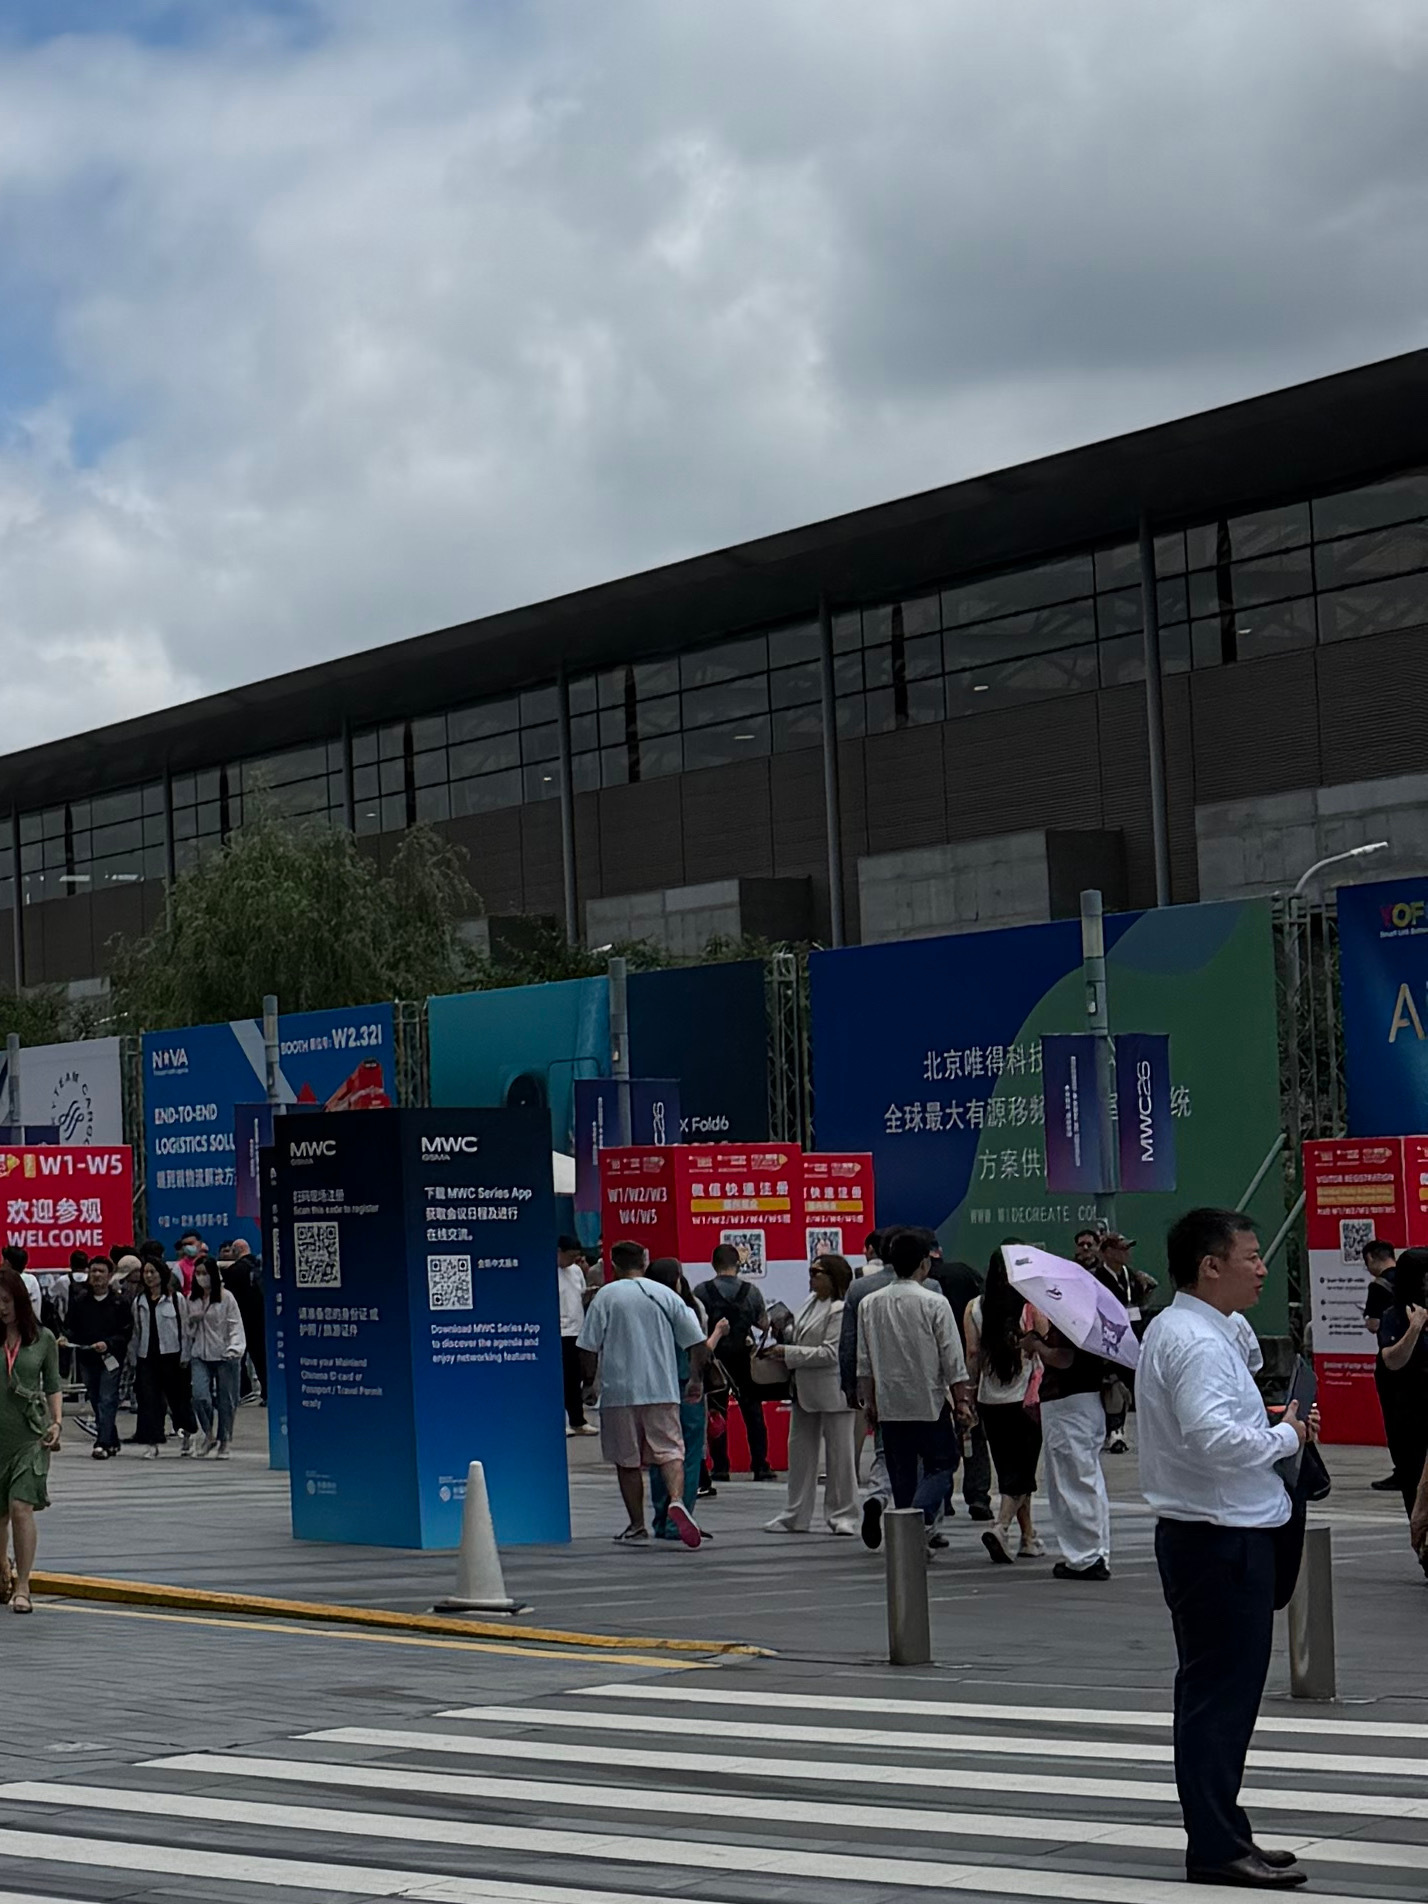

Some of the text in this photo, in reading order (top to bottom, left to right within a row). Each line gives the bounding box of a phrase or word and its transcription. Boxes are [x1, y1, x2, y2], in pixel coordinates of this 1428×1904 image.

[1380, 900, 1428, 928] YOF
[280, 1040, 309, 1055] BOOTH
[154, 1103, 218, 1125] END-TO-END
[1136, 1060, 1154, 1162] MWC26
[692, 1114, 730, 1132] Fold6
[156, 1135, 207, 1155] LOGISTICS
[289, 1140, 337, 1158] MWC
[421, 1136, 479, 1153] MWC
[39, 1154, 124, 1177] W1-W5
[978, 1147, 1047, 1181] 方案供
[447, 1187, 476, 1199] MWC
[478, 1187, 510, 1199] Series
[511, 1187, 533, 1201] App
[607, 1186, 668, 1203] W1/W2/W3
[6, 1197, 103, 1224] 欢迎参观
[619, 1208, 657, 1225] W4/W5
[6, 1228, 104, 1247] WELCOME
[430, 1322, 541, 1335] Download MWC Series App
[432, 1336, 539, 1350] to discover the agenda and
[432, 1353, 455, 1365] enjoy
[456, 1351, 502, 1364] networking
